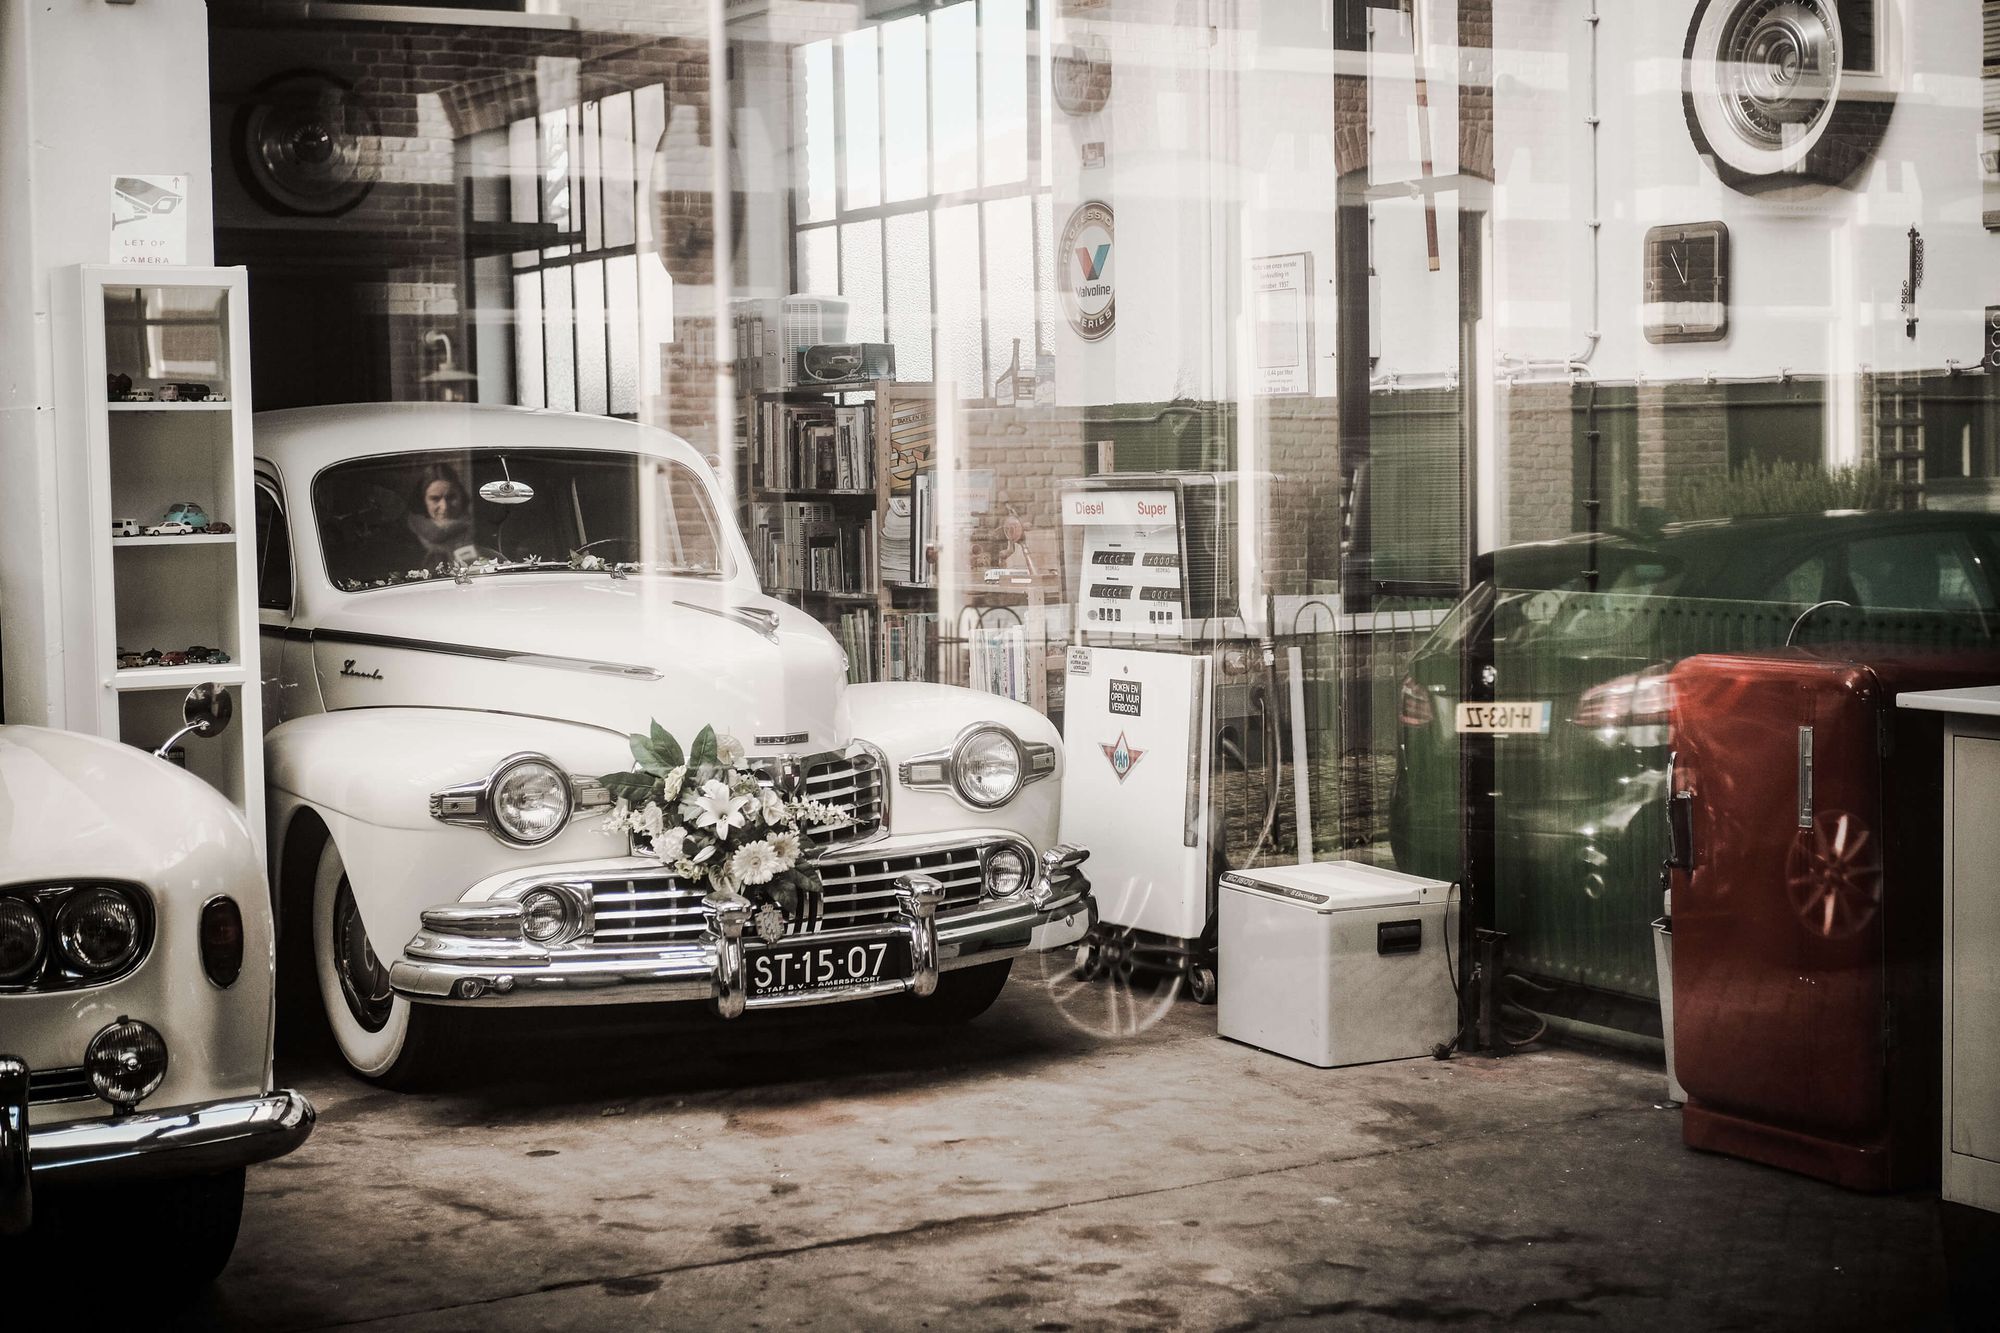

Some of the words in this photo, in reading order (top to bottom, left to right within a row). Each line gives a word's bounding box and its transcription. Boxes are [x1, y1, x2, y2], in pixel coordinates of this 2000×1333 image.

[1062, 208, 1114, 265] PROFESSIO
[124, 239, 145, 247] LET
[121, 256, 170, 265] CAMERA
[1075, 283, 1111, 298] Valvoline
[1077, 308, 1112, 329] ERIES
[1075, 501, 1105, 515] Diesel
[1137, 501, 1168, 518] Super
[1112, 682, 1130, 693] ROKEN
[1130, 684, 1139, 694] EN
[1110, 692, 1125, 702] OPEN
[1125, 693, 1140, 704] VUUR
[1111, 702, 1139, 714] VERBODEN
[754, 943, 888, 988] ST-15-07
[817, 976, 881, 988] AMERSFOORT
